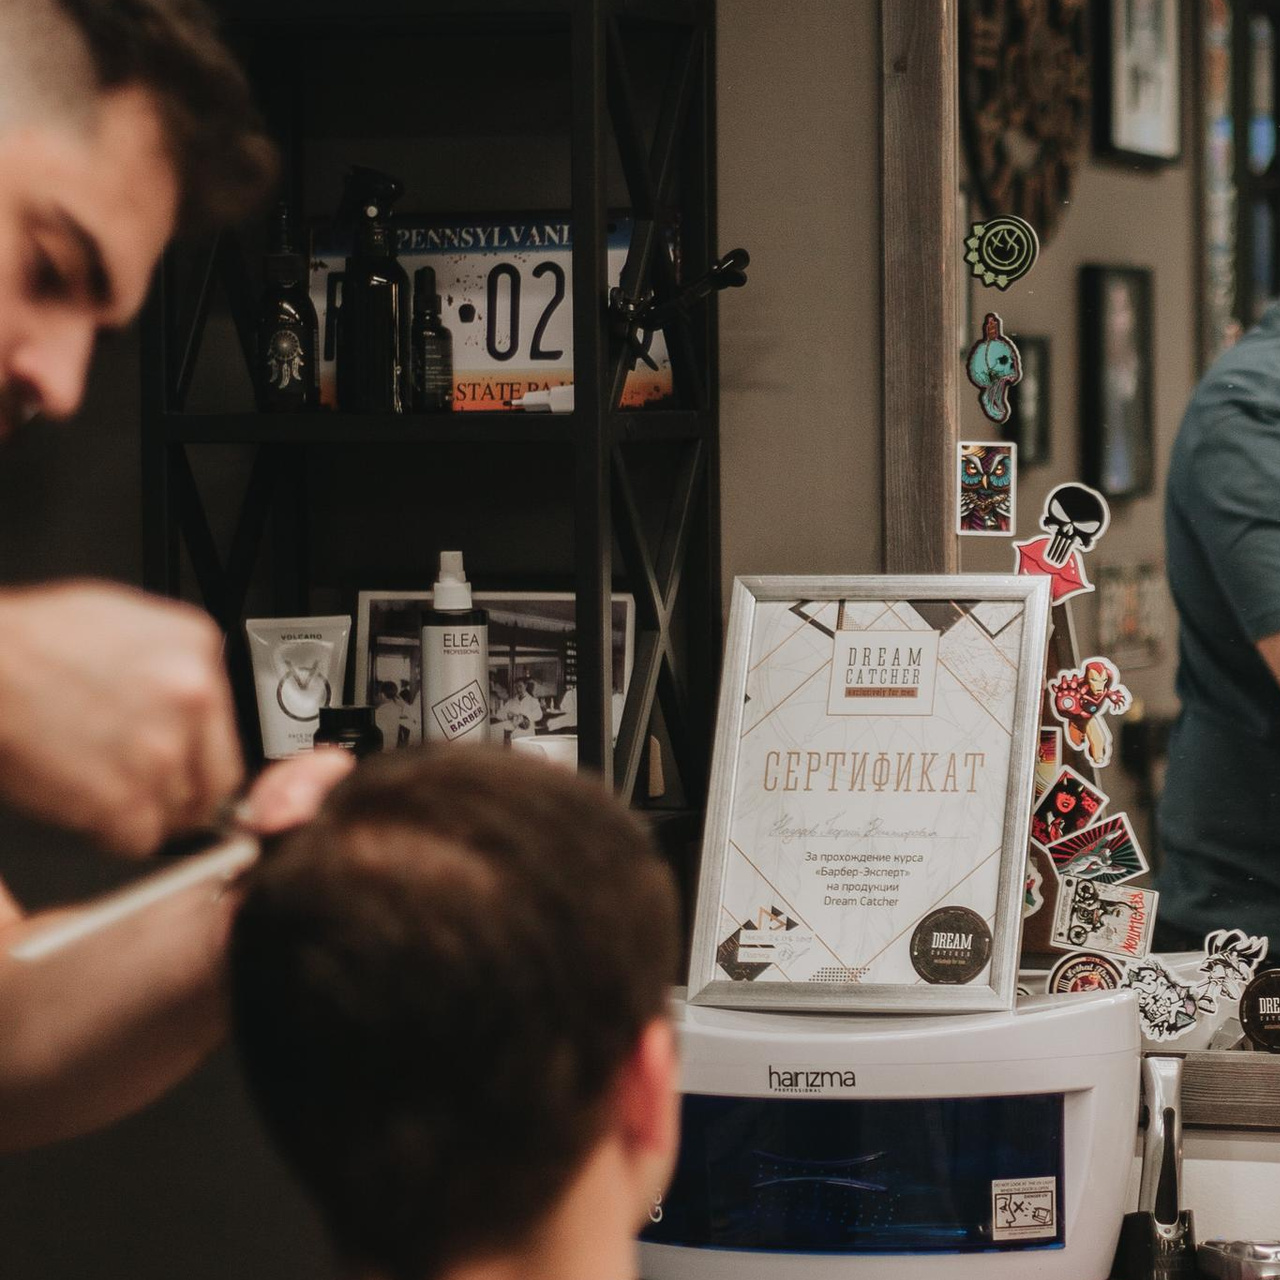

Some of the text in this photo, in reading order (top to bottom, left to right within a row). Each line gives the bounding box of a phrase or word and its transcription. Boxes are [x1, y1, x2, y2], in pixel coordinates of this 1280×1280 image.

[396, 224, 572, 250] PENNSYLVANI
[456, 382, 522, 401] STATE
[443, 633, 480, 649] ELEA
[848, 646, 923, 667] DREAM
[845, 668, 921, 685] CATCHER
[441, 690, 480, 725] LUXOR
[449, 706, 485, 733] BARBER
[763, 751, 986, 793] СЕРТИФИКАТ
[805, 852, 923, 865] За прохождение курса
[826, 883, 899, 894] на продукции
[824, 896, 899, 907] Dream Catcher
[1123, 889, 1145, 955] REVOLUTION
[931, 932, 974, 950] DREAM
[769, 1065, 856, 1089] harizma
